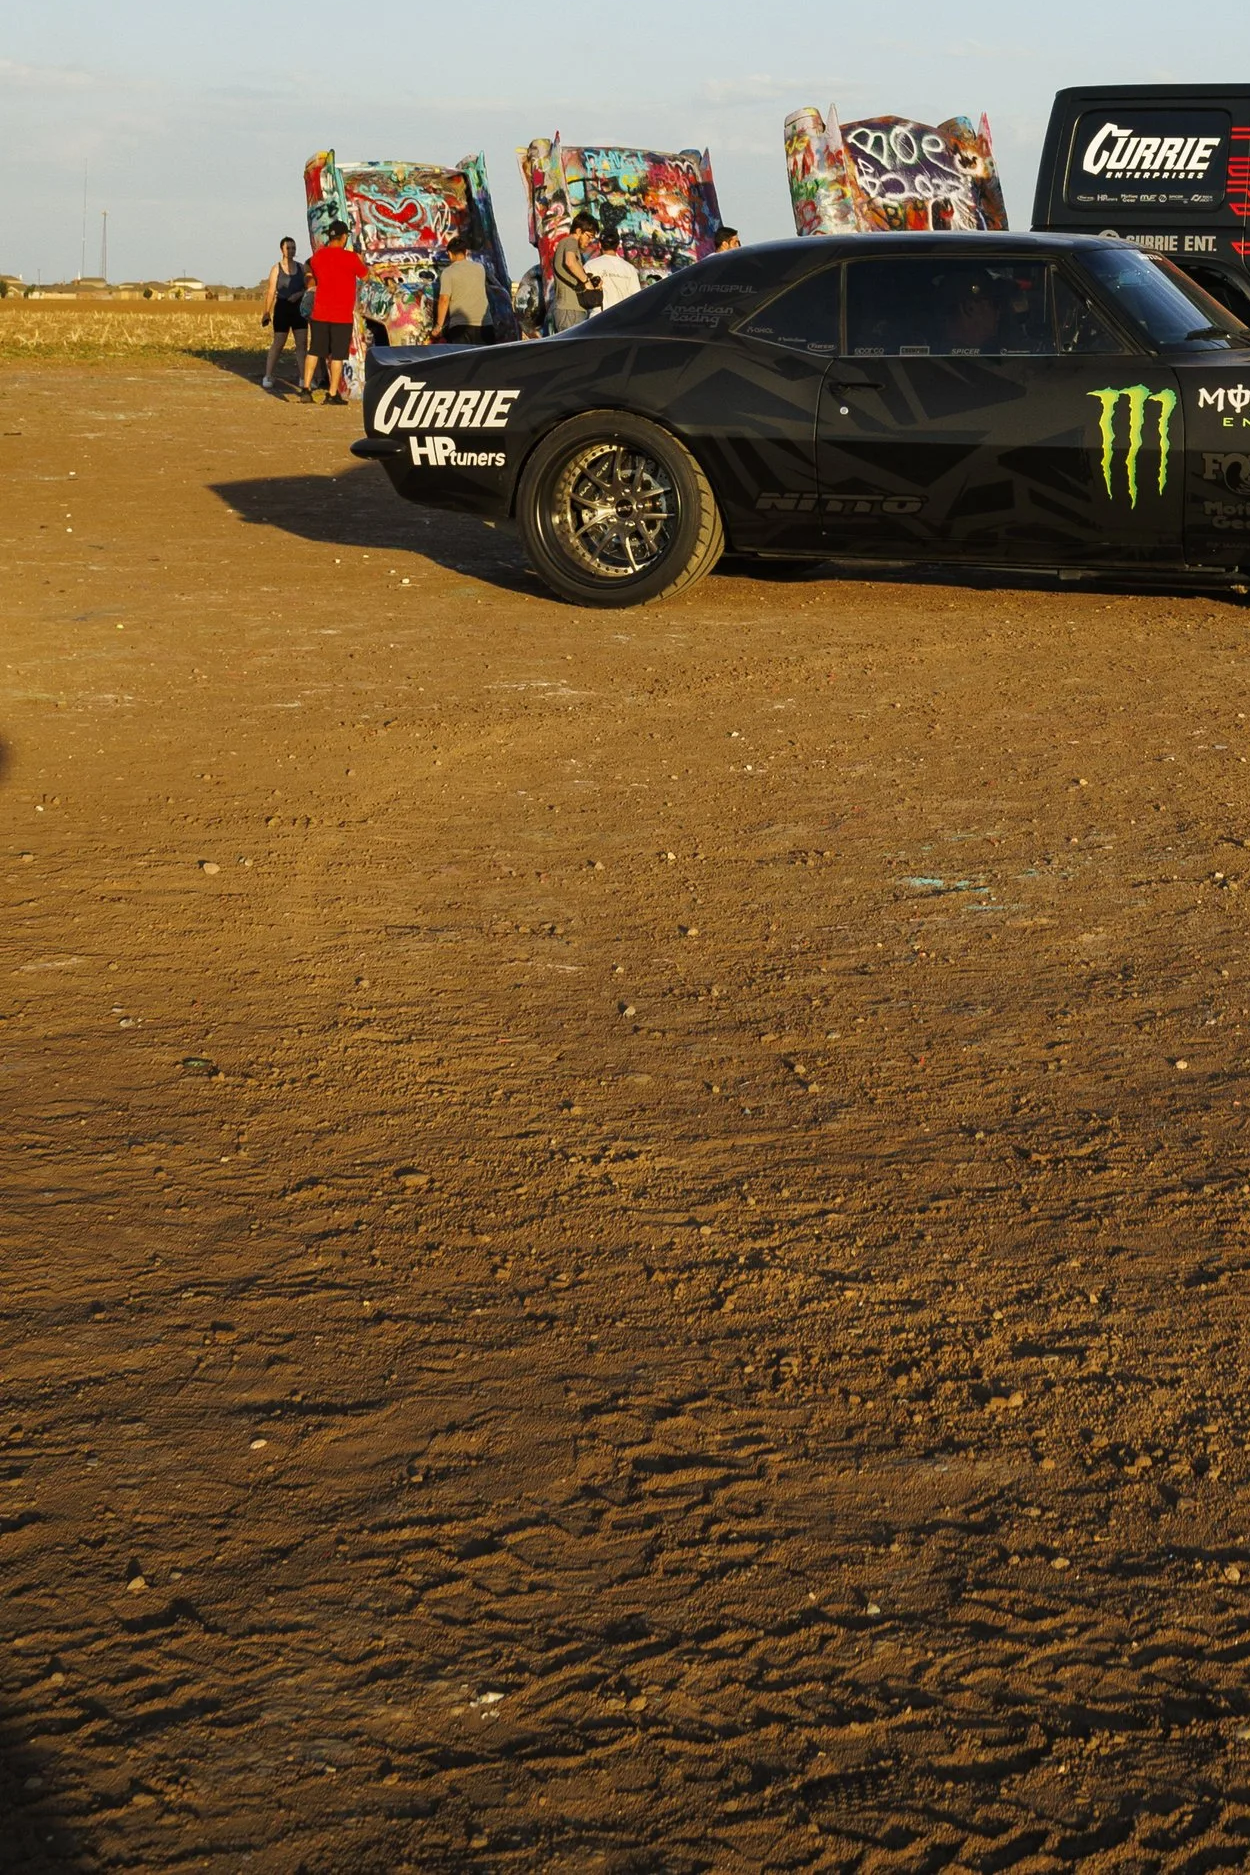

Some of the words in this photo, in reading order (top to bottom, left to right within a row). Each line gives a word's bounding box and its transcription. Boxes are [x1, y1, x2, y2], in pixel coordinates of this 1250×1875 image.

[1083, 122, 1221, 175] CURRIE
[1184, 235, 1217, 251] ENT.
[698, 284, 758, 294] MAGPUL
[659, 303, 734, 315] American
[669, 312, 720, 328] Racing
[373, 375, 520, 435] CURRIE
[409, 436, 506, 466] HPtuners
[754, 491, 923, 516] NITTO
